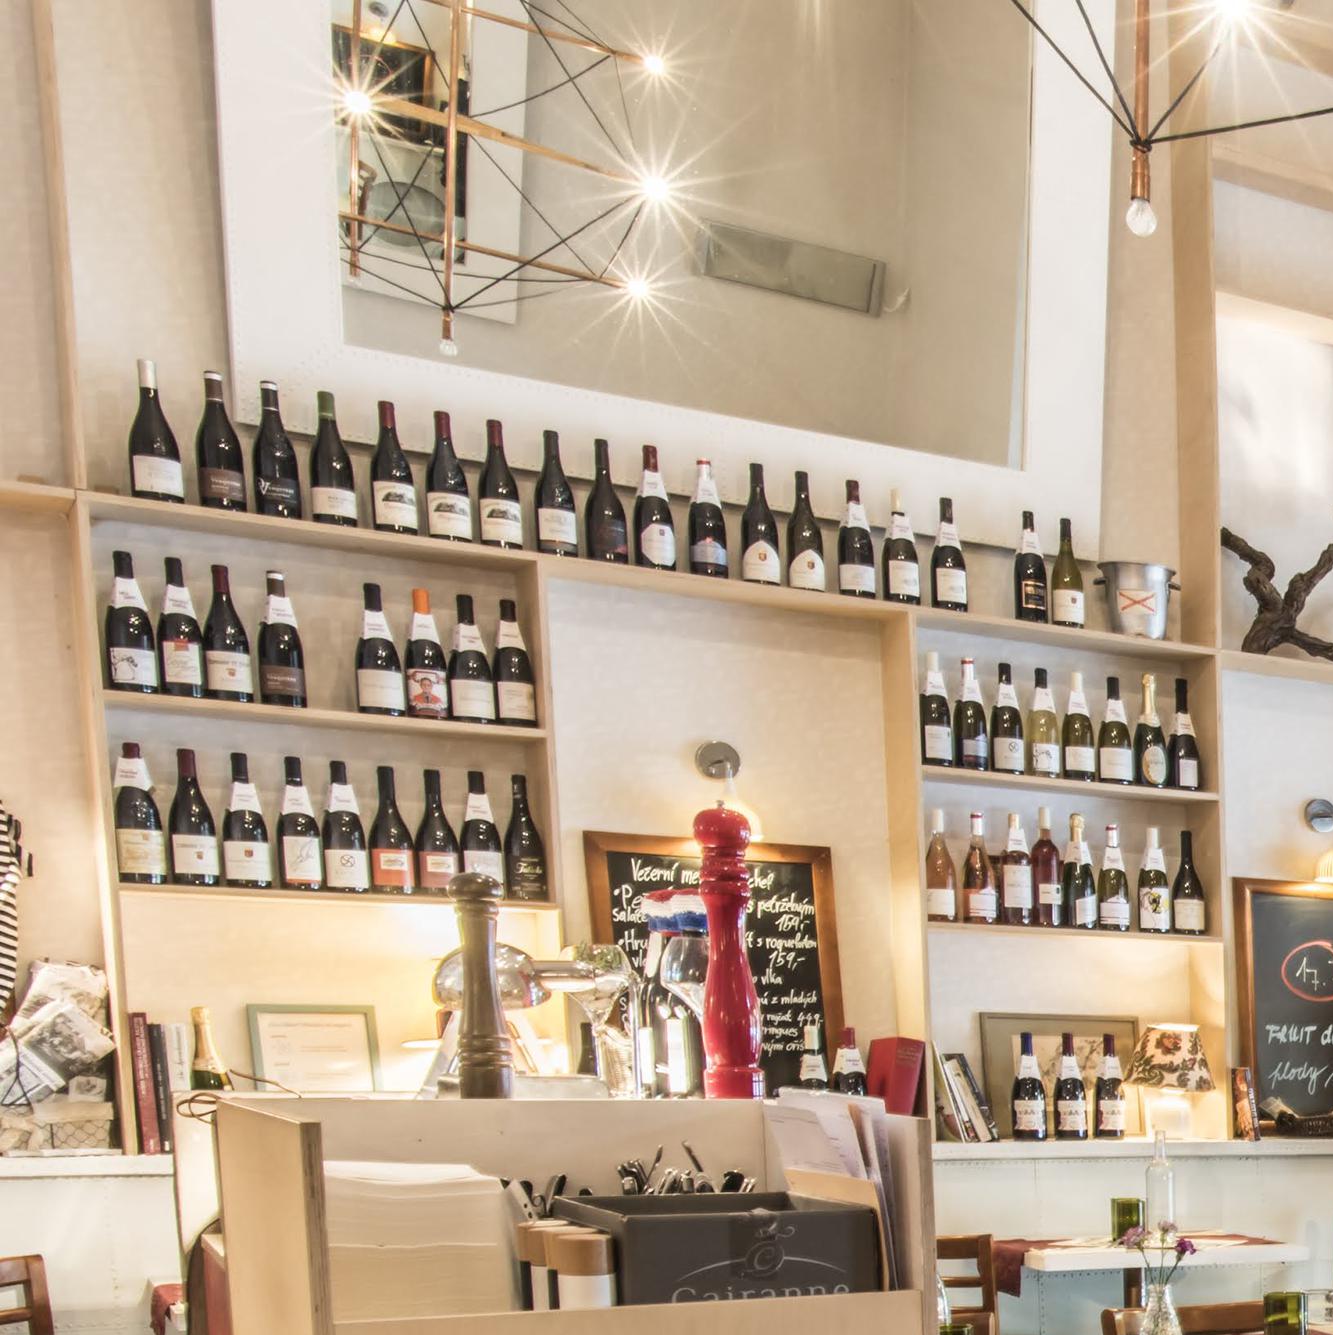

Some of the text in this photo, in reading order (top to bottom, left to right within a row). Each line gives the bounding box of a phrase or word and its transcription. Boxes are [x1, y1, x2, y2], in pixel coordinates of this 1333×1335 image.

[630, 857, 680, 882] Večerní
[680, 869, 701, 885] me
[620, 884, 646, 910] Pe
[623, 928, 649, 952] Hru
[768, 950, 806, 971] 159,-
[785, 1040, 805, 1051] oříš
[1265, 1024, 1317, 1045] FRUIT
